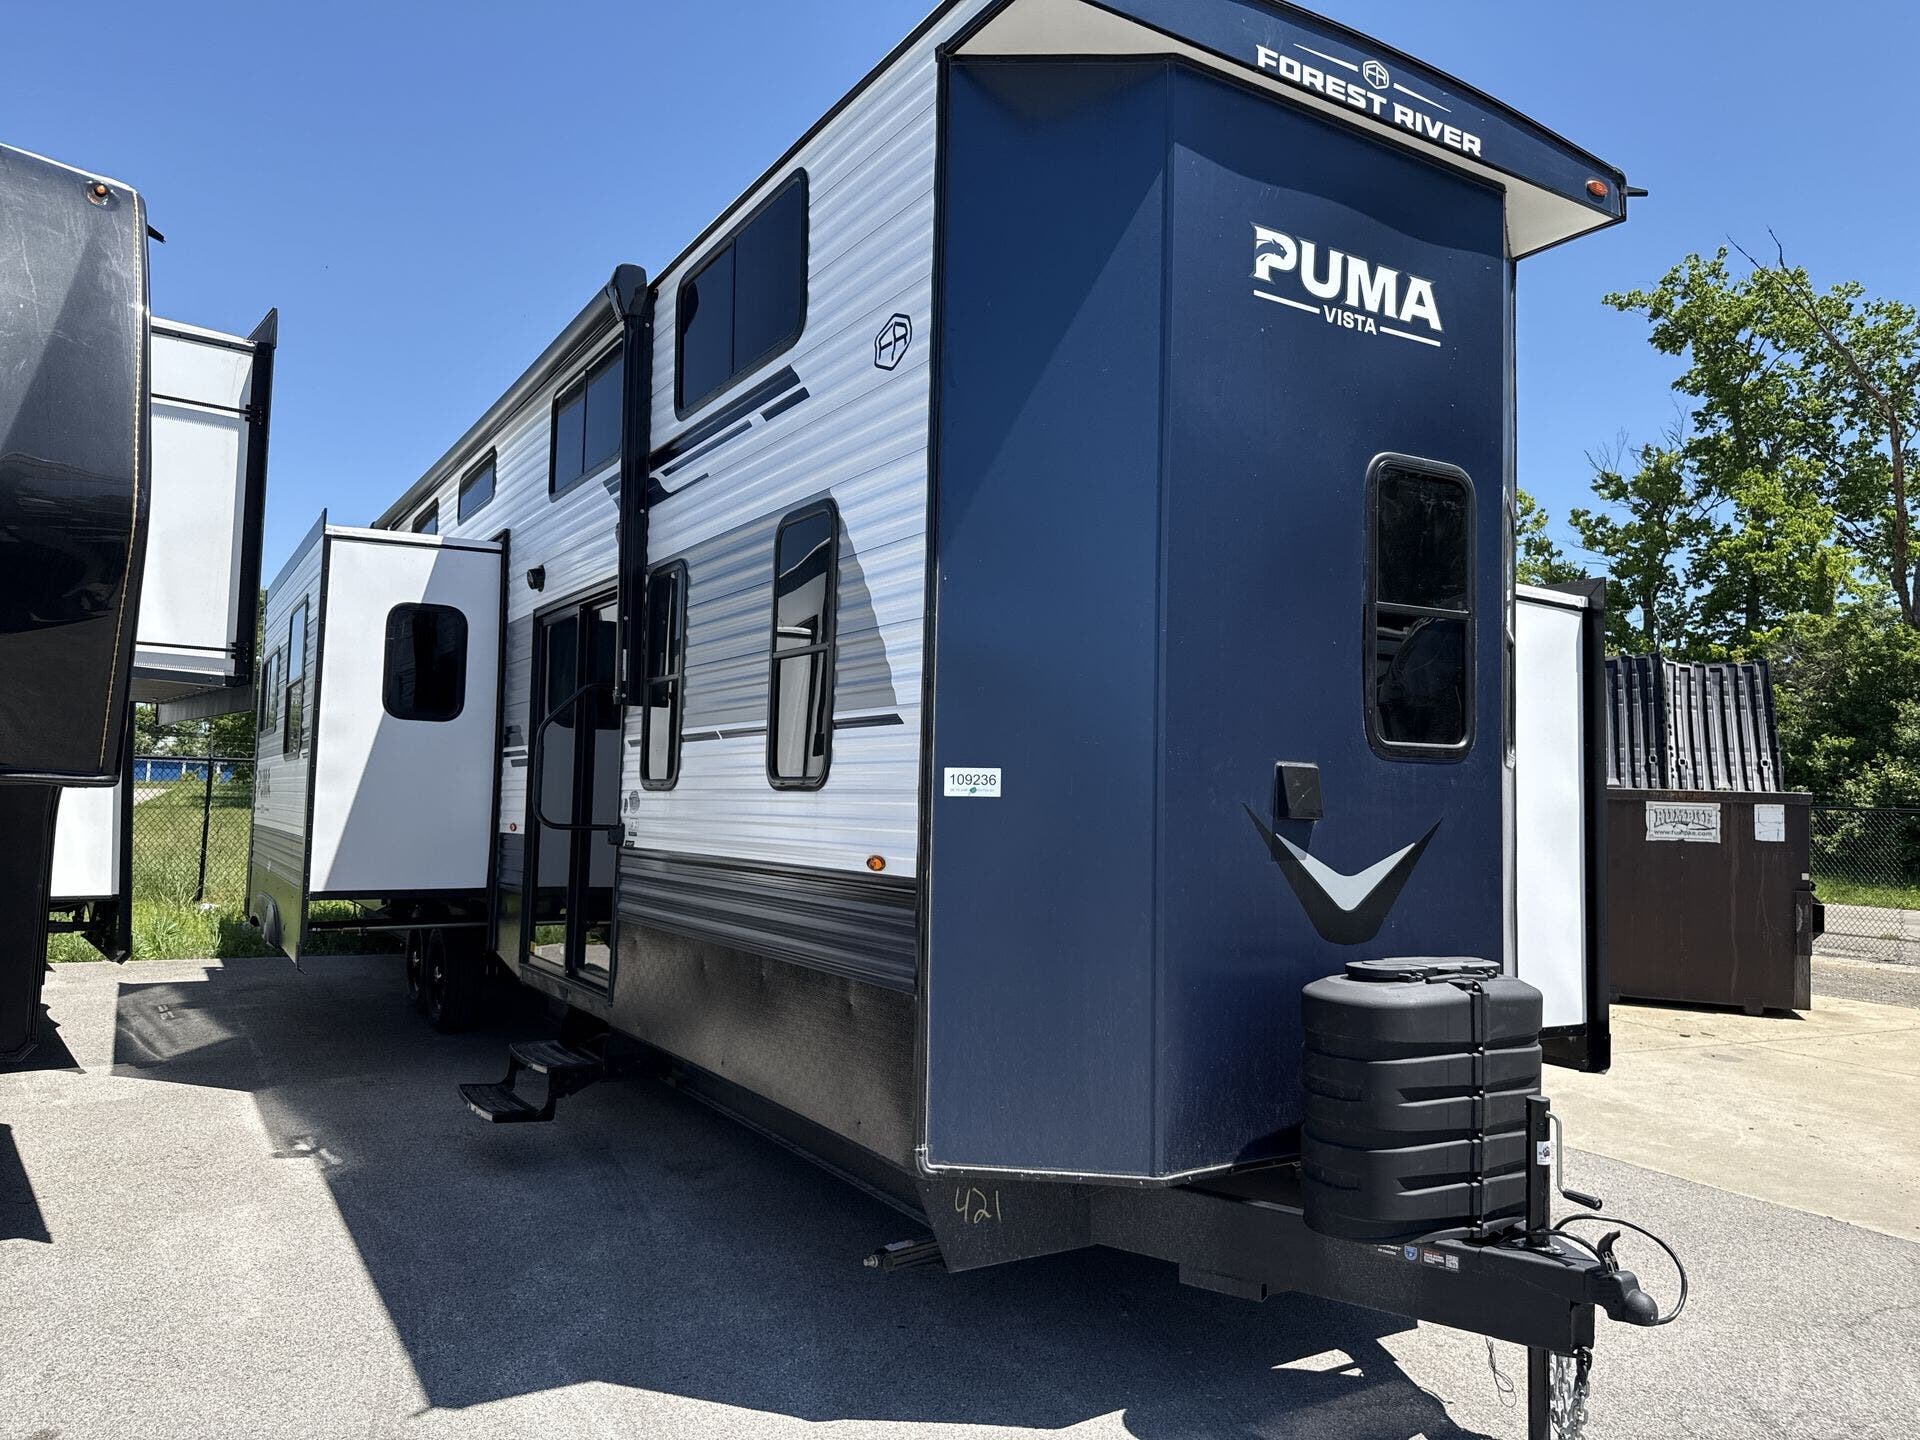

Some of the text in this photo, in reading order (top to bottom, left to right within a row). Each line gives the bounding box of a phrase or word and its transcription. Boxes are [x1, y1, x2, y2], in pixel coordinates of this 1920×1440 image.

[1256, 45, 1482, 157] FOREST RIVER
[1253, 225, 1442, 331] PUMA
[1323, 305, 1377, 335] VISTA
[950, 773, 997, 786] 109236
[955, 1186, 1002, 1224] 421
